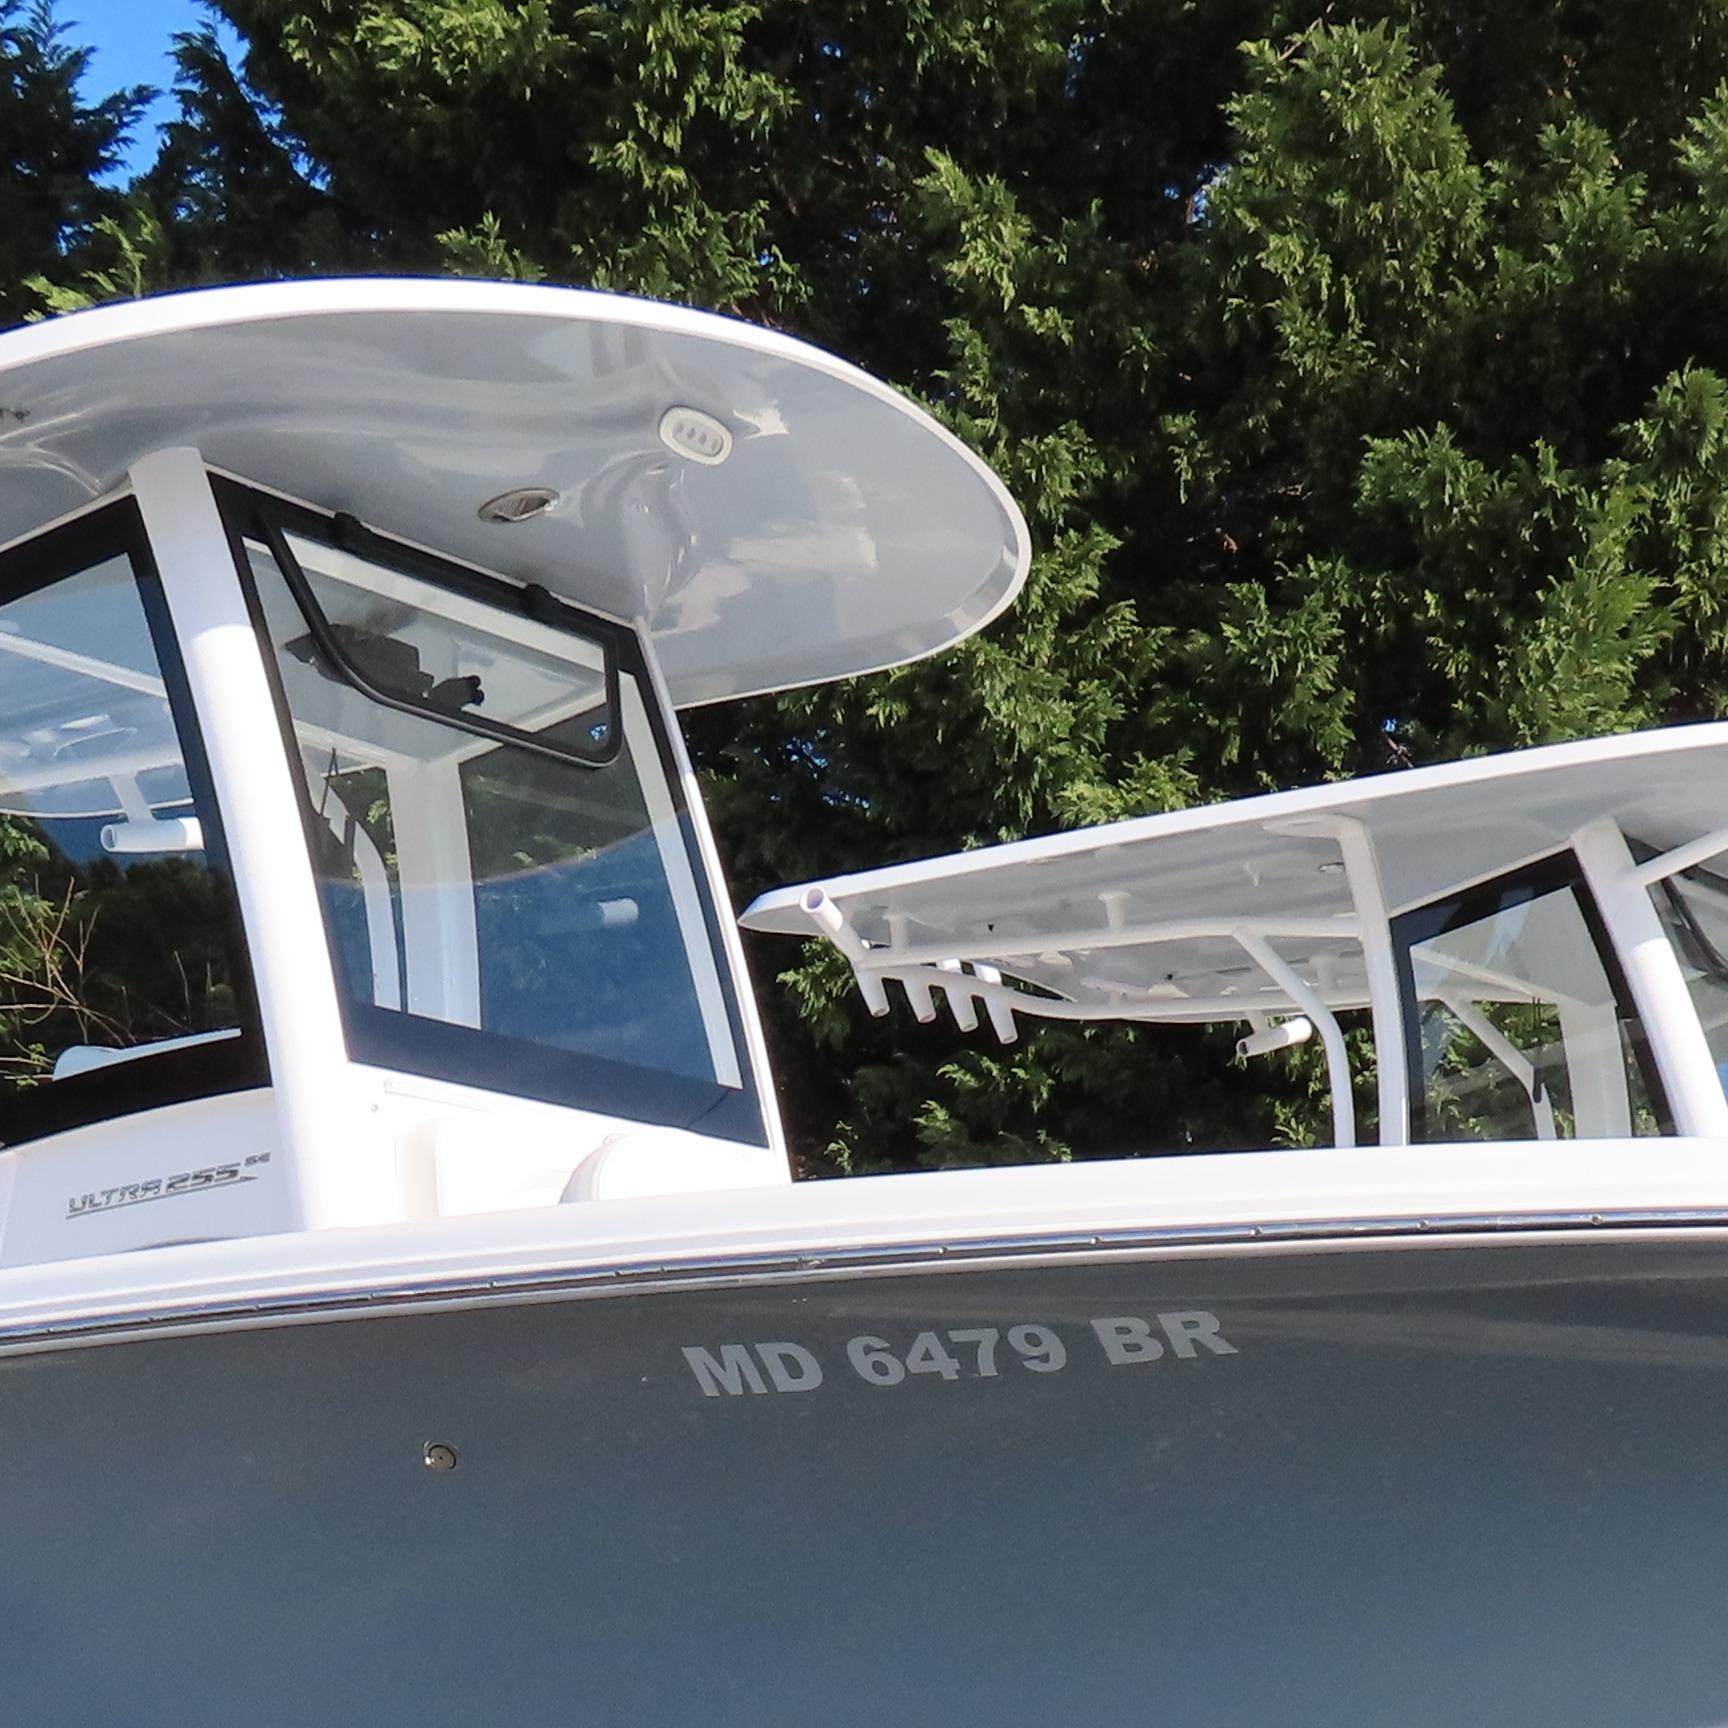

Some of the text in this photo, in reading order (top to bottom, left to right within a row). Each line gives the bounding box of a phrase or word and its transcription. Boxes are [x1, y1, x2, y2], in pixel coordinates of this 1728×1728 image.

[68, 1178, 163, 1213] ULTRA
[165, 1161, 242, 1194] 255
[681, 1310, 1239, 1398] MD 6479 BR
